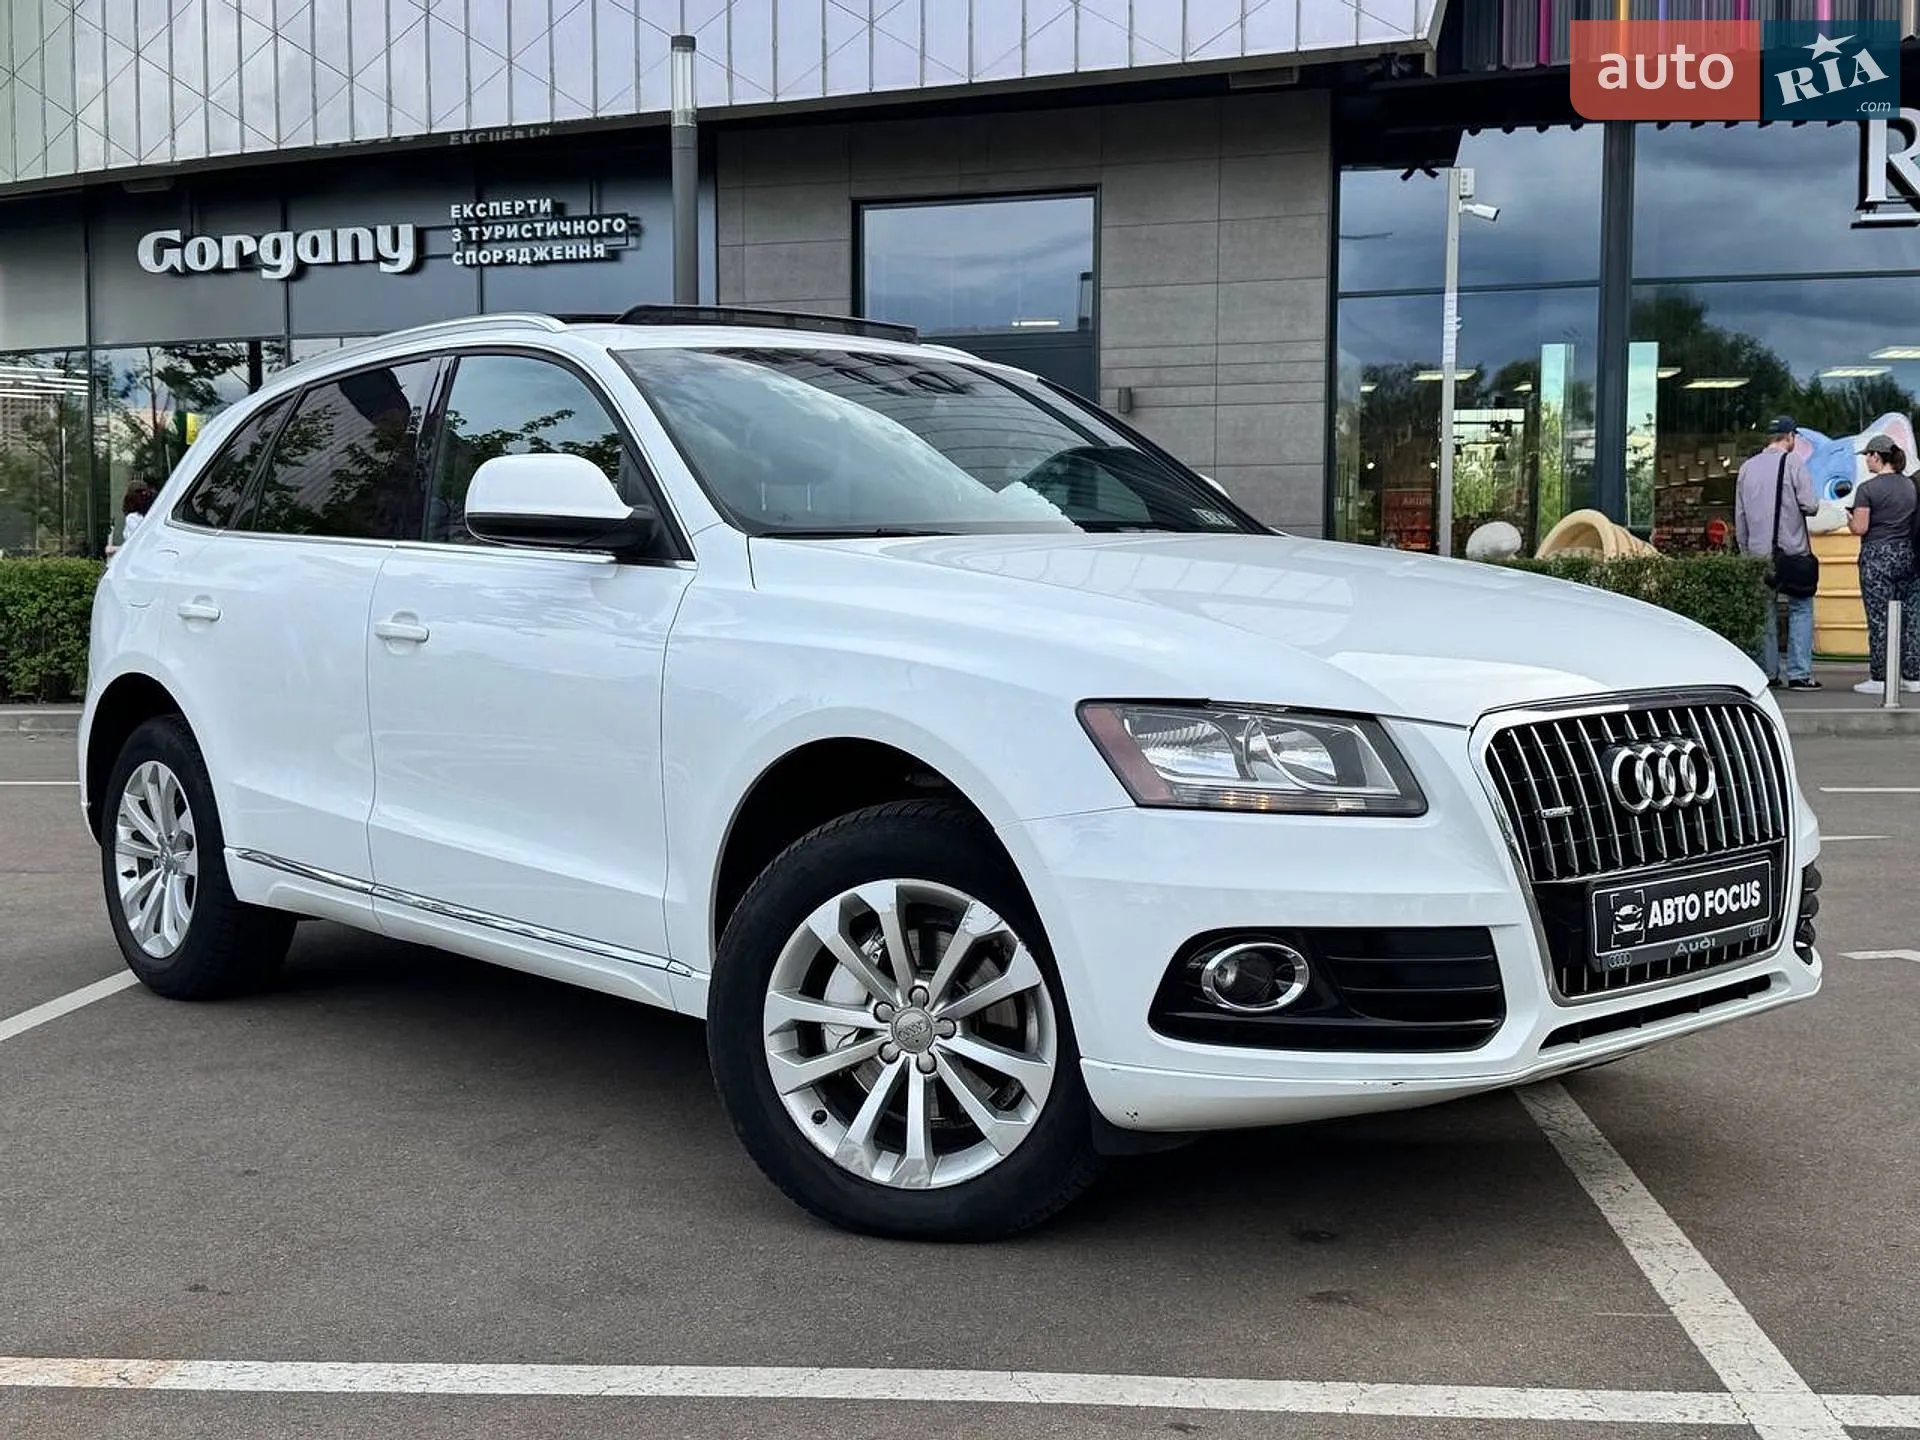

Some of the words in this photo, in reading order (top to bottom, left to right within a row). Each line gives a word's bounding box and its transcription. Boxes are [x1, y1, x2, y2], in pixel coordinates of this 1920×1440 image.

[450, 199, 552, 219] ЕКСПЕРТИ
[468, 217, 627, 242] ТУРИСТИЧНОГО
[137, 223, 417, 279] Gorgany
[452, 243, 606, 266] СПОРЯДЖЕННЯ
[1704, 880, 1761, 917] FOCUS
[1674, 937, 1717, 956] Audi
